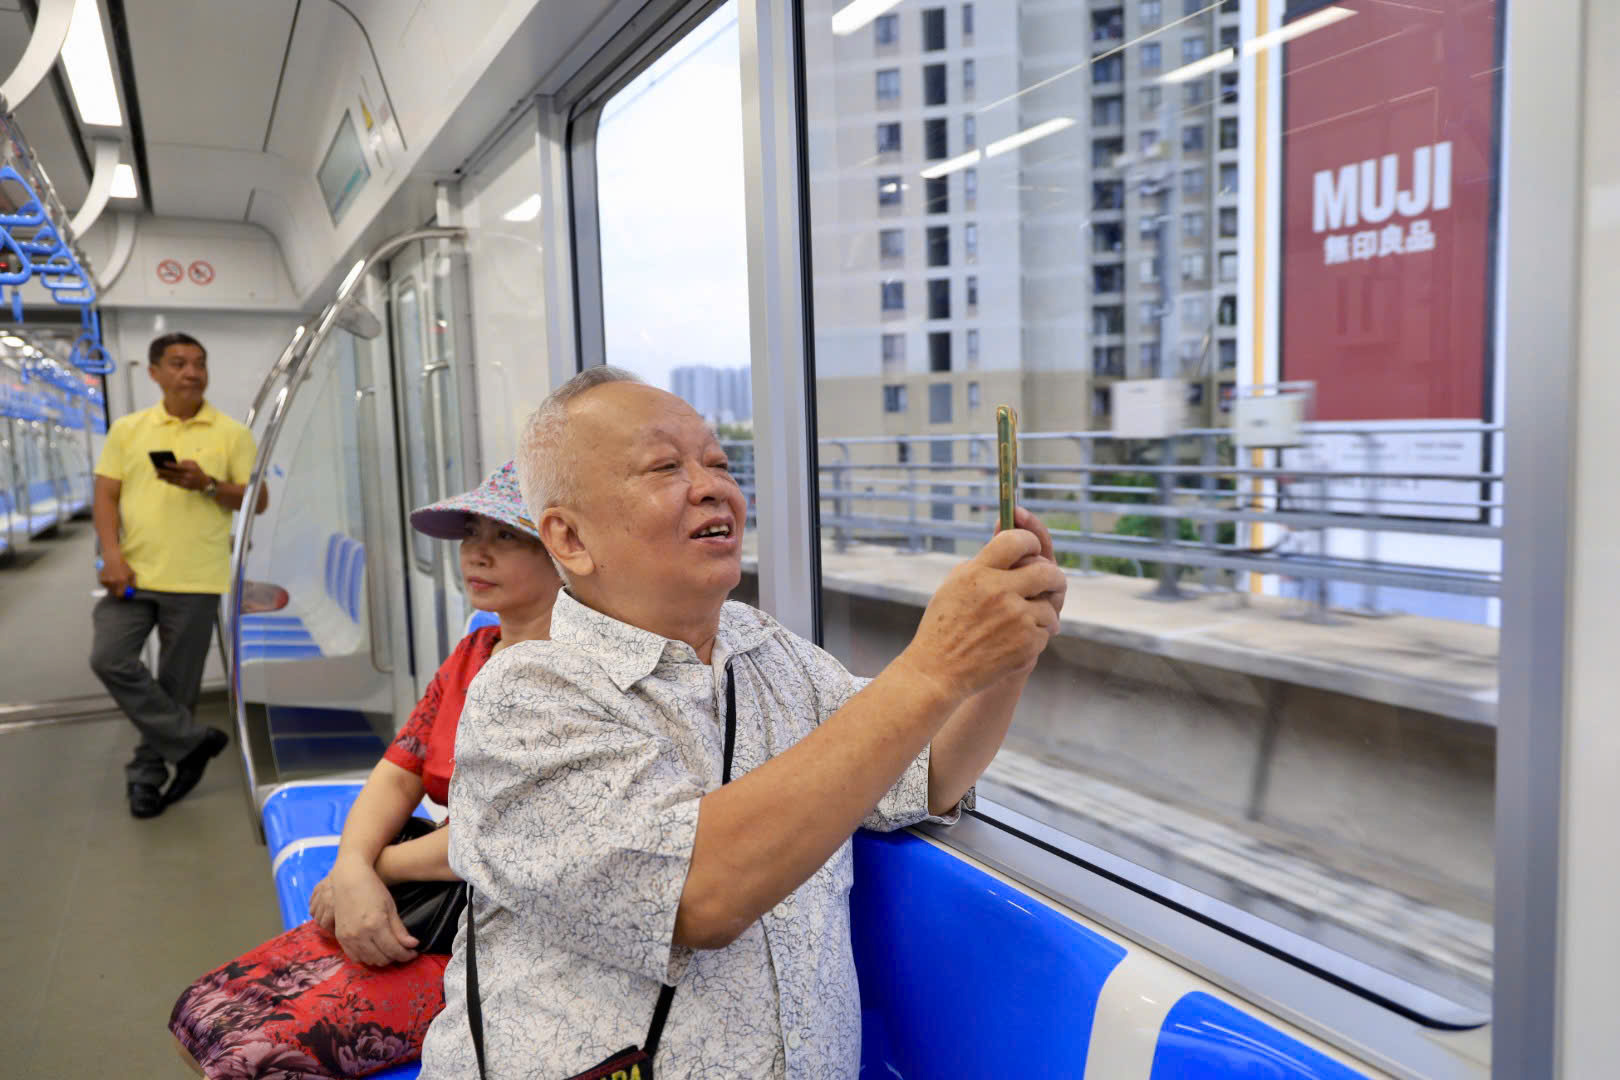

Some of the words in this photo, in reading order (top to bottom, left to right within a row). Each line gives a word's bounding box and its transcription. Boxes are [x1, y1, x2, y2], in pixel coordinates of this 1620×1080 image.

[1313, 141, 1452, 232] MUJI
[1324, 219, 1436, 266] 無印良品
